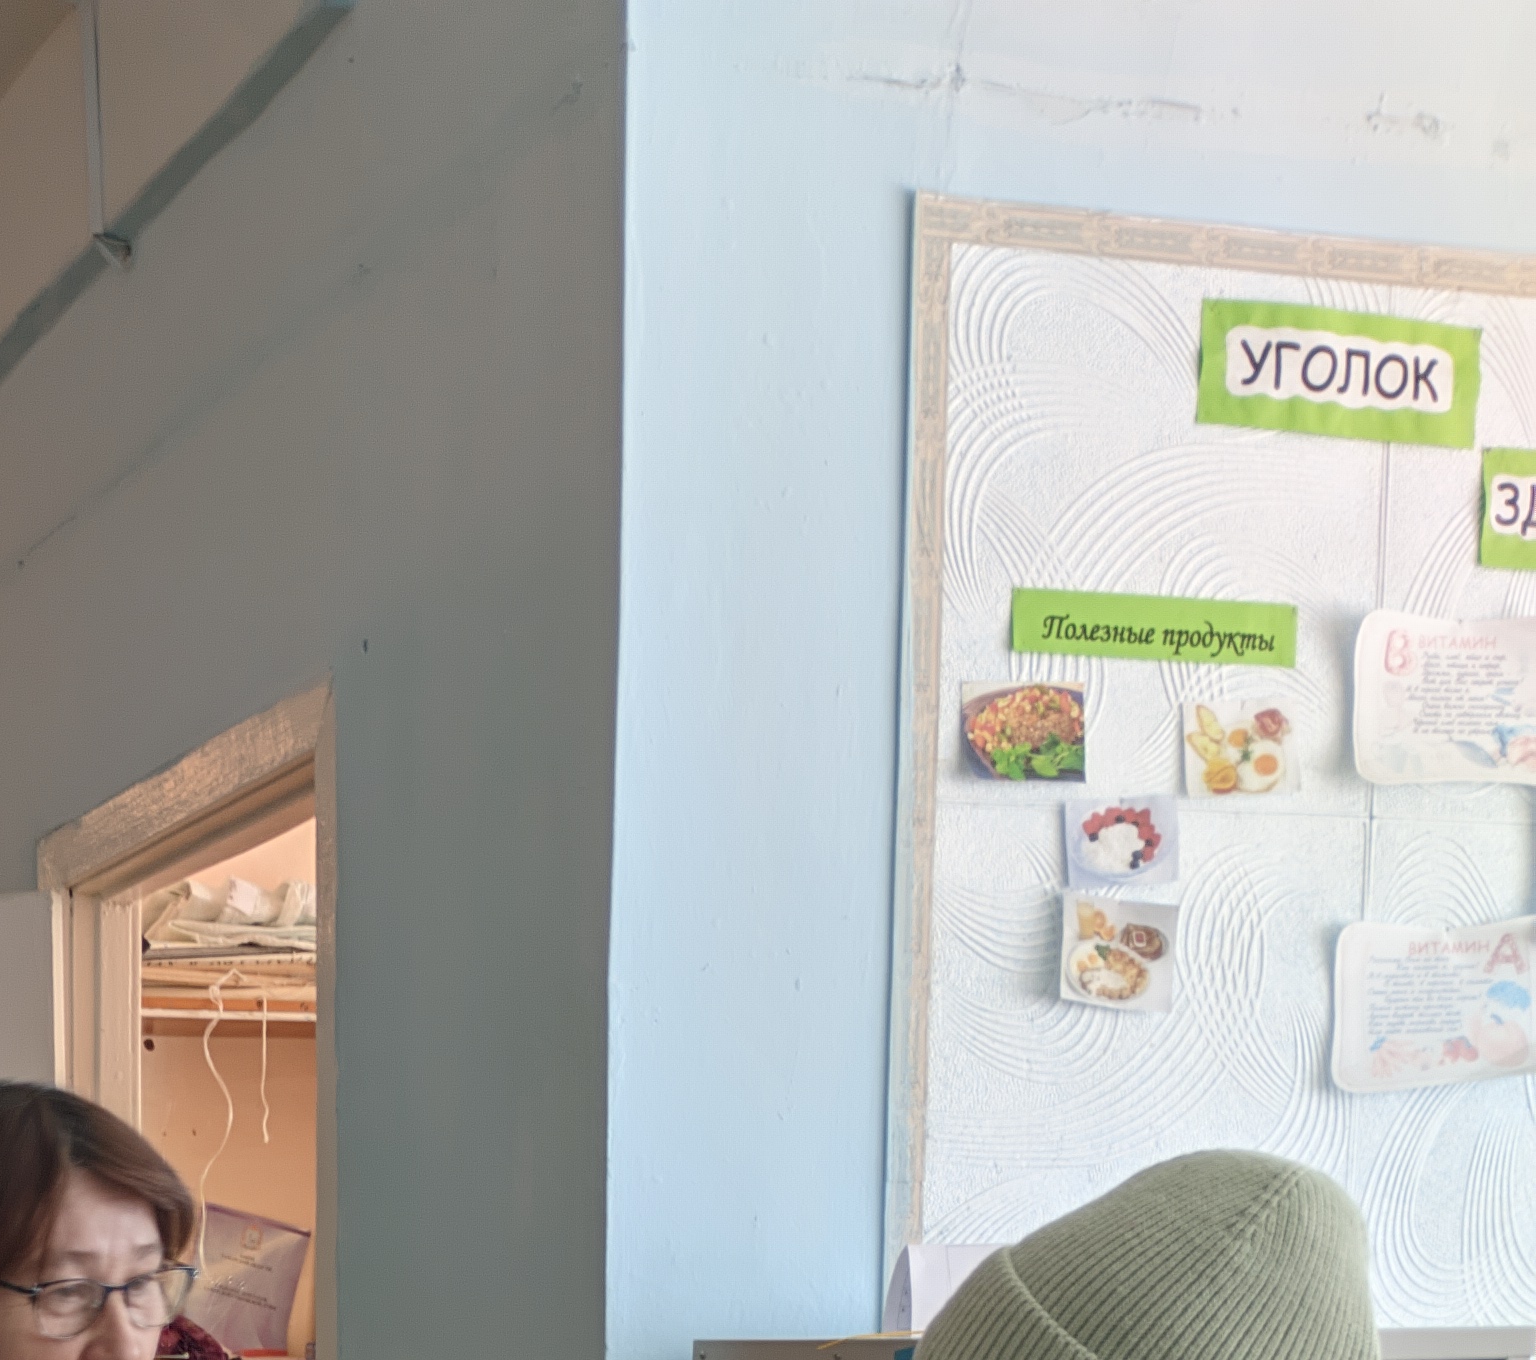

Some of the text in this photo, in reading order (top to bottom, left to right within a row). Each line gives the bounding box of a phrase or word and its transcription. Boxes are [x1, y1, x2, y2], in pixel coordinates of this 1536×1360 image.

[1240, 338, 1439, 403] УГОЛОК
[1041, 613, 1276, 658] Полезные продукты
[1418, 635, 1498, 650] ВИТАМИН
[1408, 940, 1490, 957] ВИТАМИН
